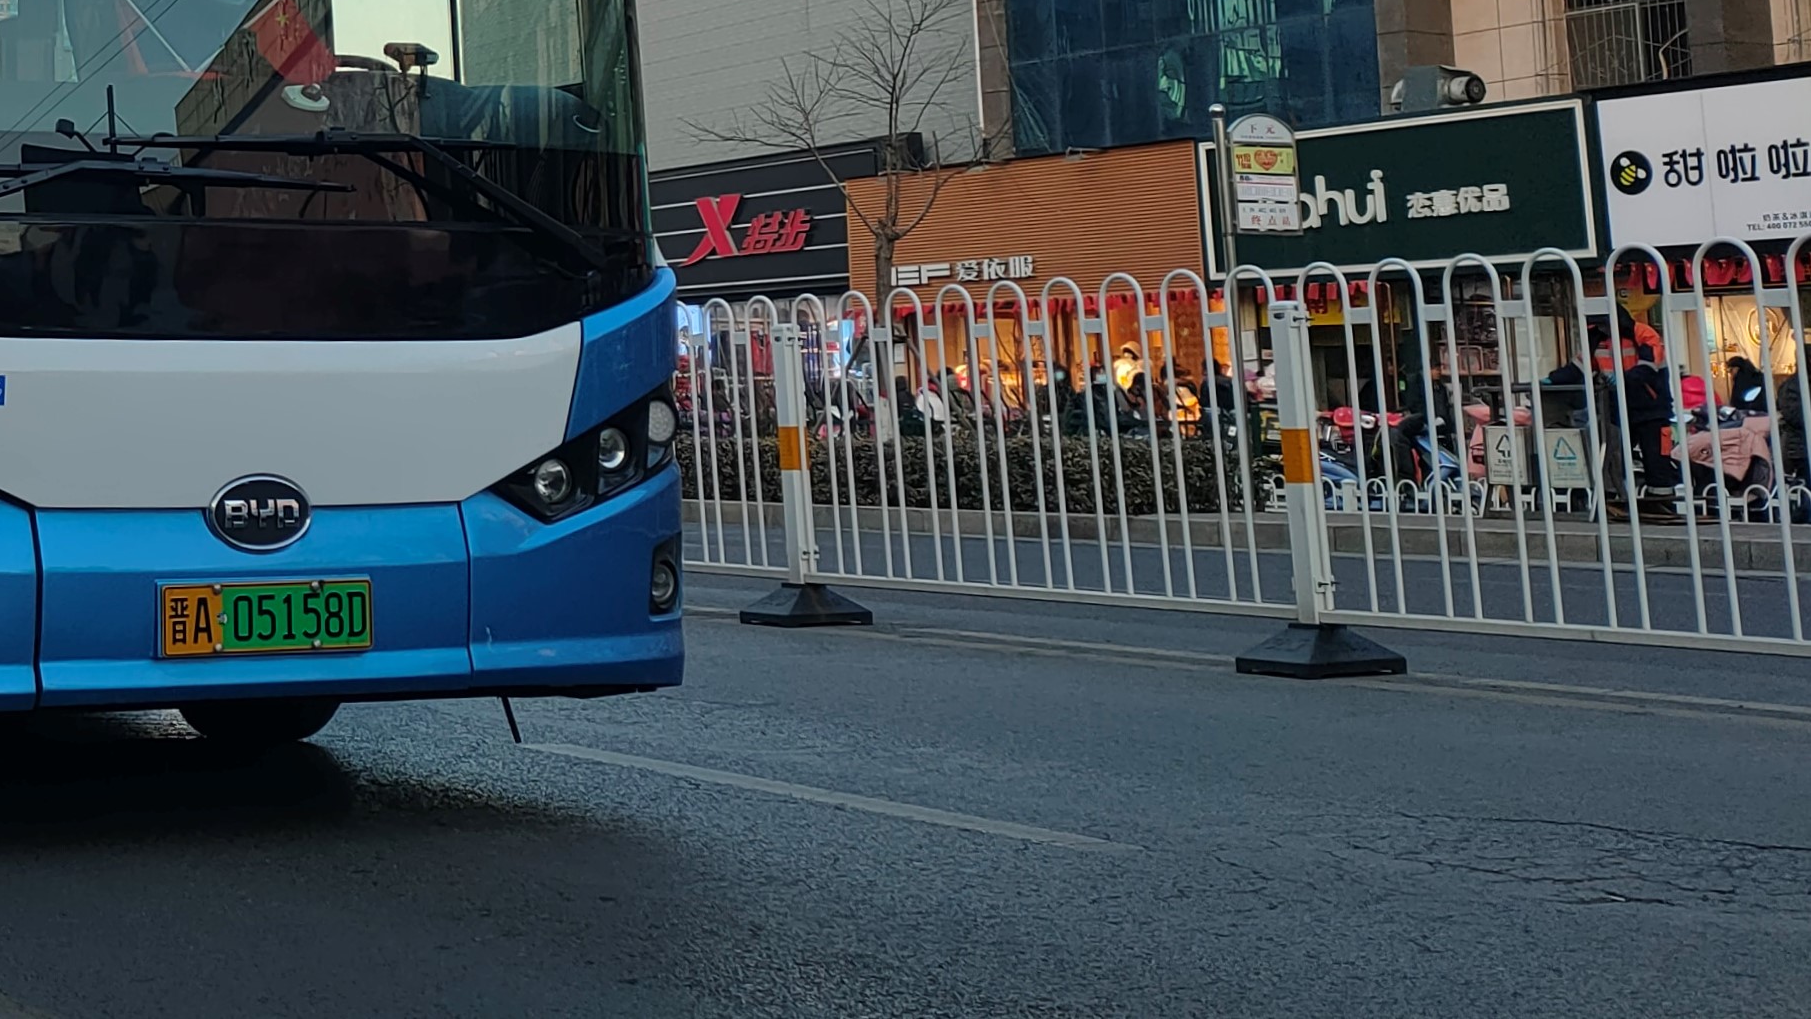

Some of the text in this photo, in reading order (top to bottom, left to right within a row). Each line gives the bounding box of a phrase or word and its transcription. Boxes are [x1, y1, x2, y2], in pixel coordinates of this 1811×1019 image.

[1662, 137, 1811, 188] 甜啦啦
[740, 208, 813, 256] 特步
[956, 255, 1036, 281] 爱依服
[224, 498, 300, 529] BYD
